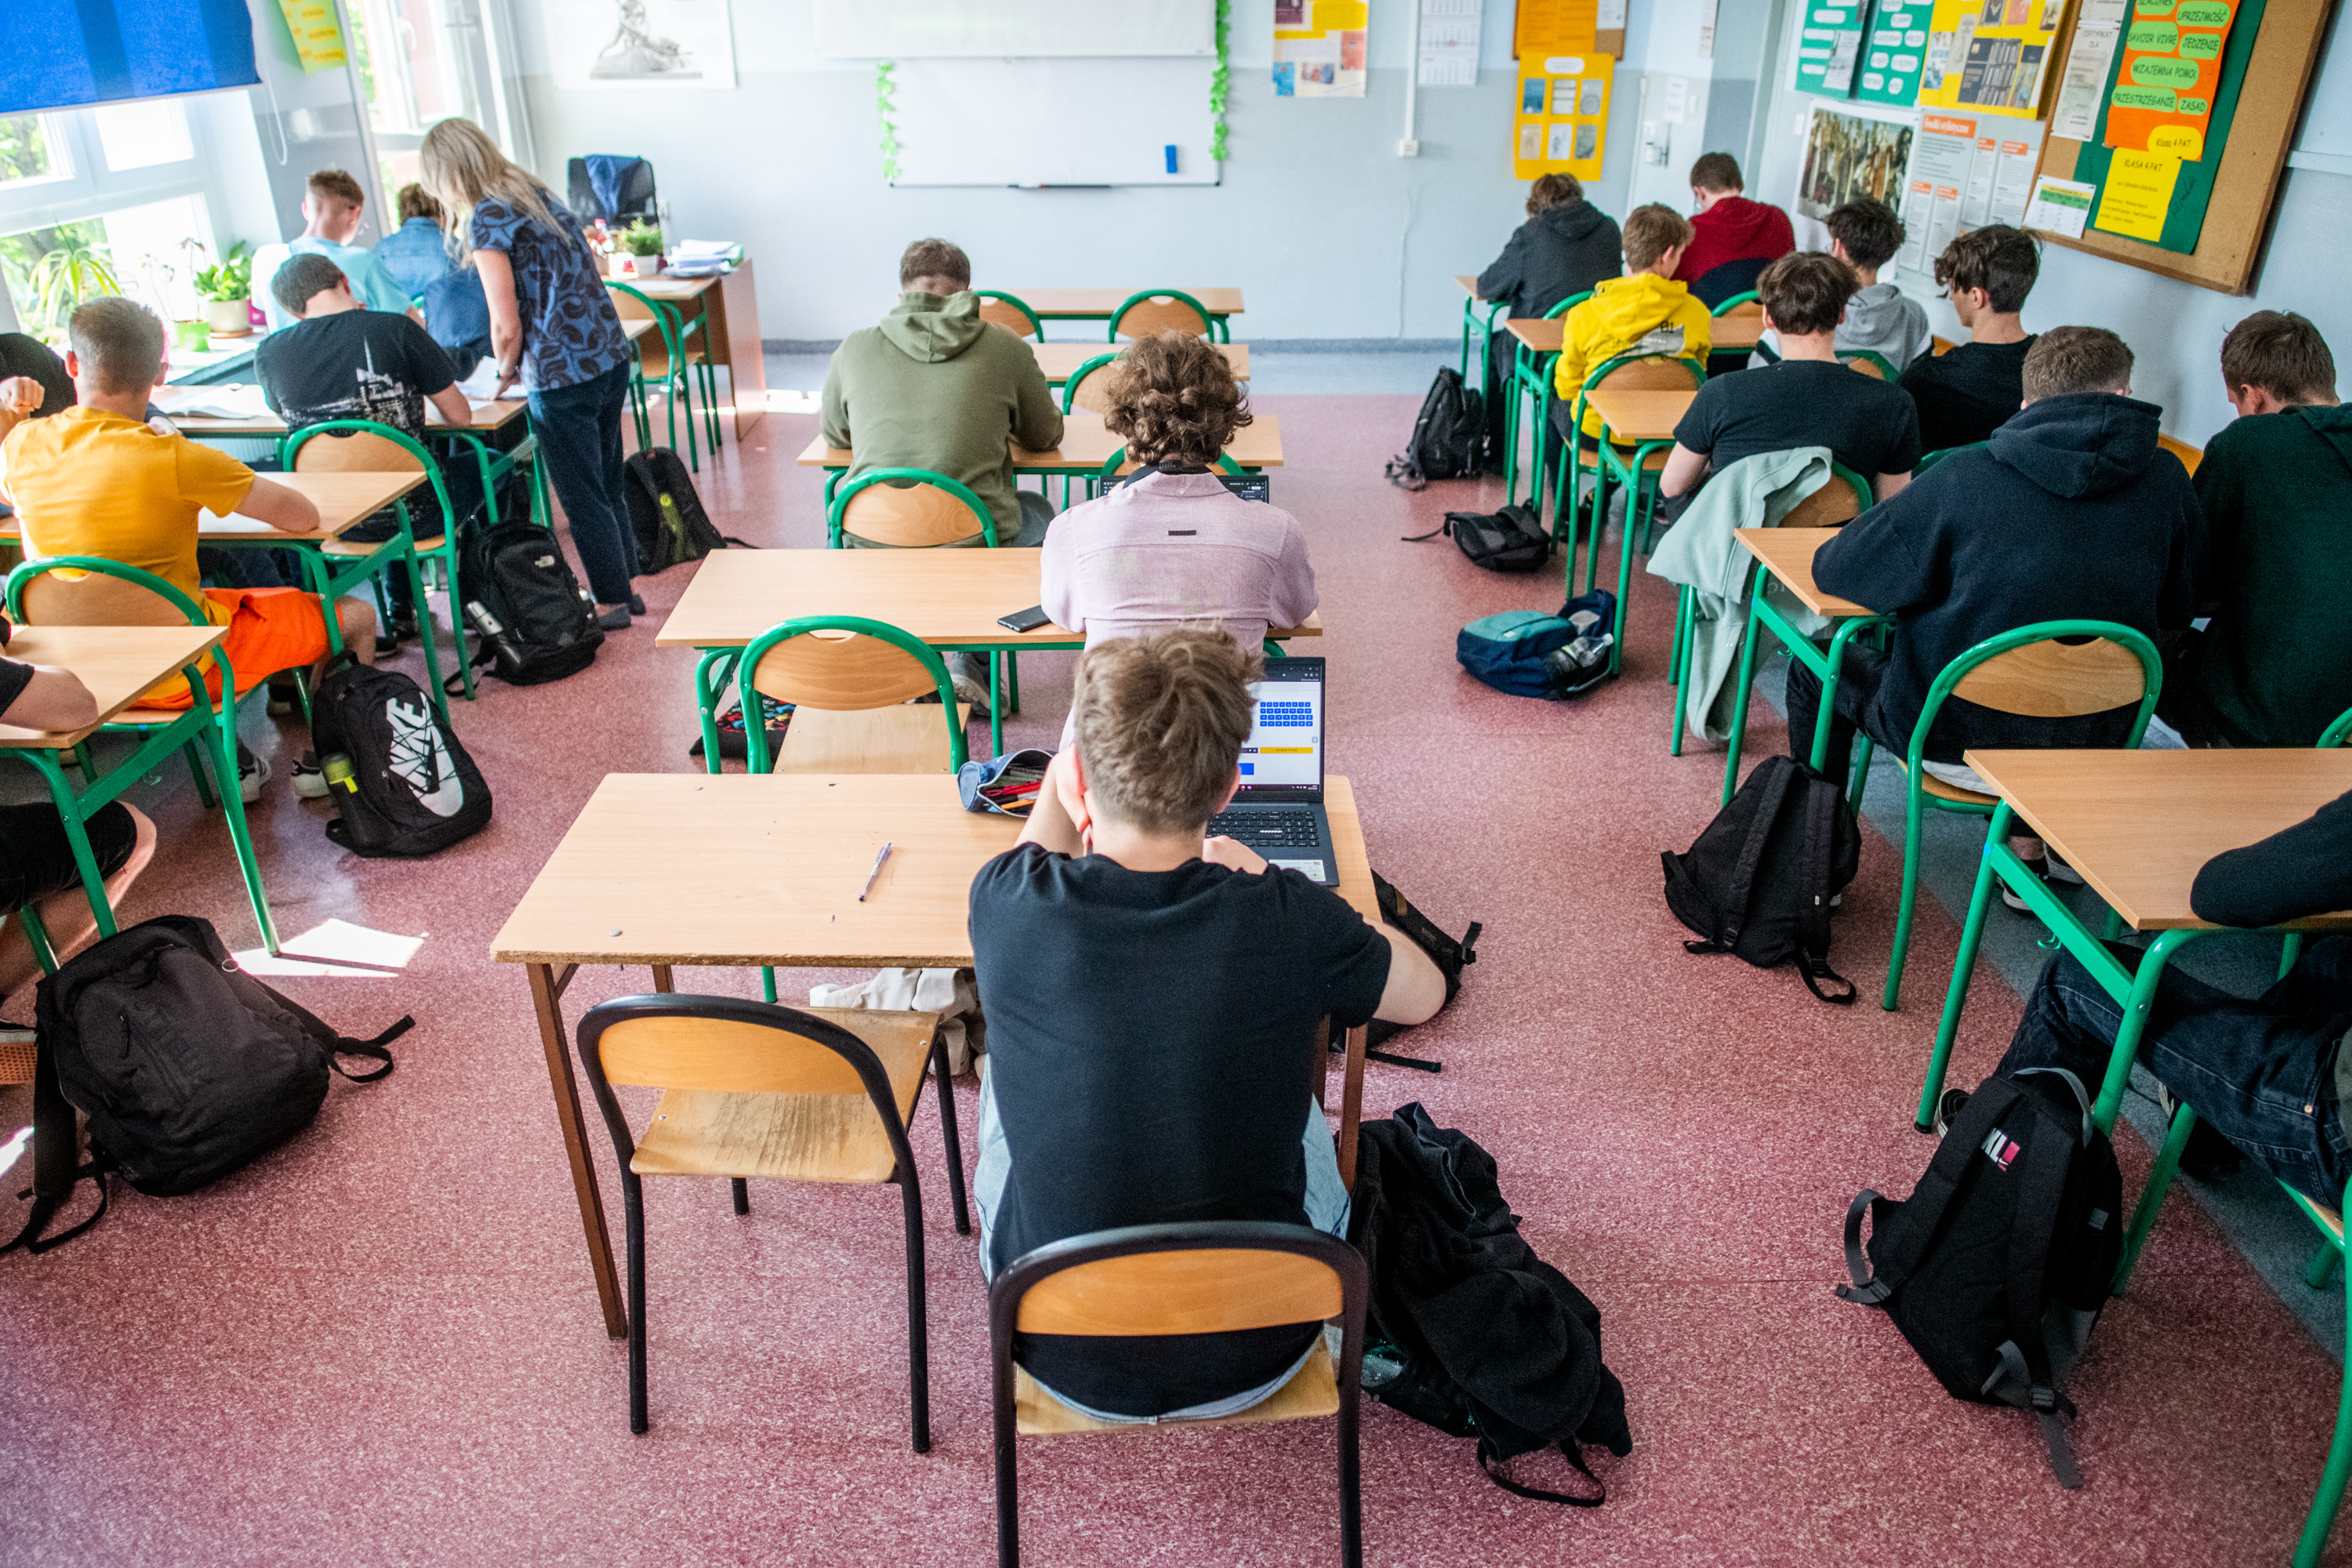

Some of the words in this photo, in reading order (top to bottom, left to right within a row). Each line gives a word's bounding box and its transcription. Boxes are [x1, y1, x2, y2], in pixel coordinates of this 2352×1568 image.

[2177, 9, 2227, 23] UPRZEJMOŚĆ
[2128, 33, 2154, 43] SAVOIR
[2157, 34, 2178, 45] VIVRE
[2183, 38, 2220, 51] JEDZENIE
[2132, 64, 2172, 76] WZAJEMNA
[2114, 93, 2176, 108] PRZESTRZEGANIE
[2180, 100, 2206, 112] ZASAD
